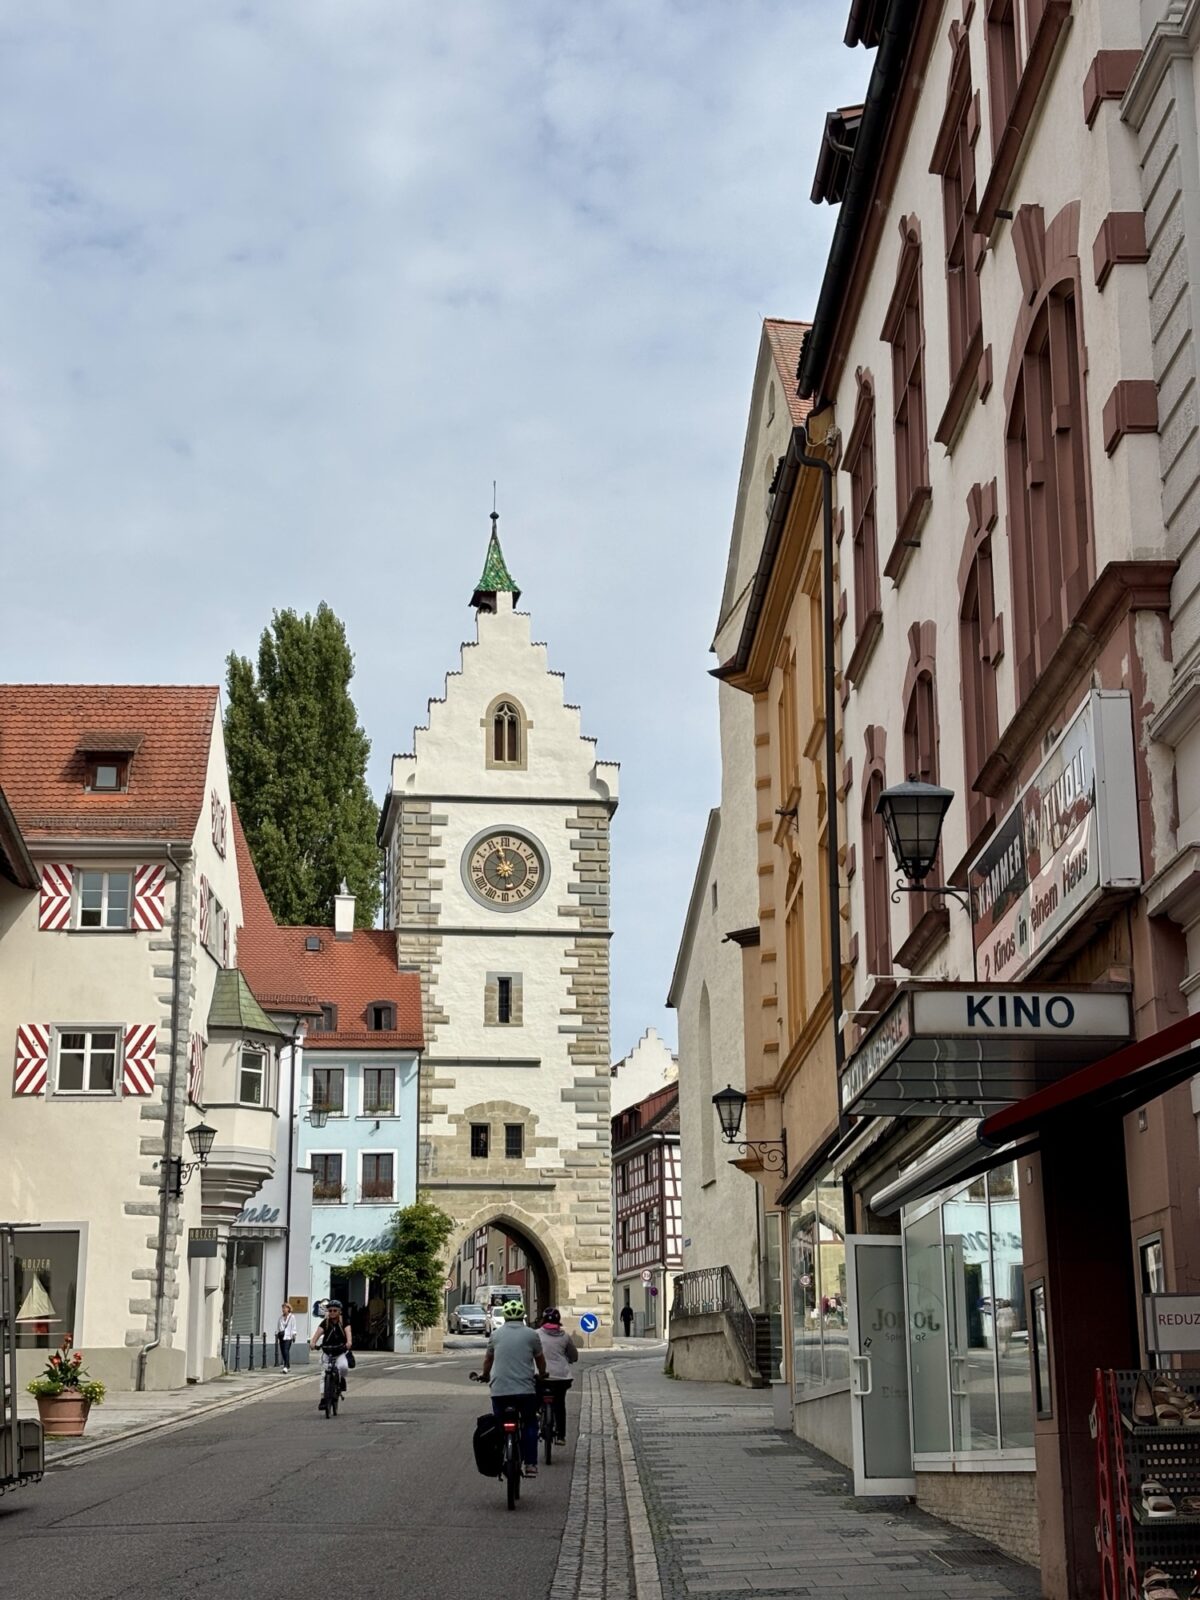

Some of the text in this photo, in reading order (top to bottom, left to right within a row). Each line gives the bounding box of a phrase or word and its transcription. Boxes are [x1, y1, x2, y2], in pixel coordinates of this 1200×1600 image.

[1043, 746, 1086, 831] TIVOLI
[978, 834, 1022, 918] KAMMER
[984, 849, 1088, 982] 2 Kinos in einem Haus
[966, 995, 1075, 1028] KINO
[22, 1258, 50, 1269] HOLZER
